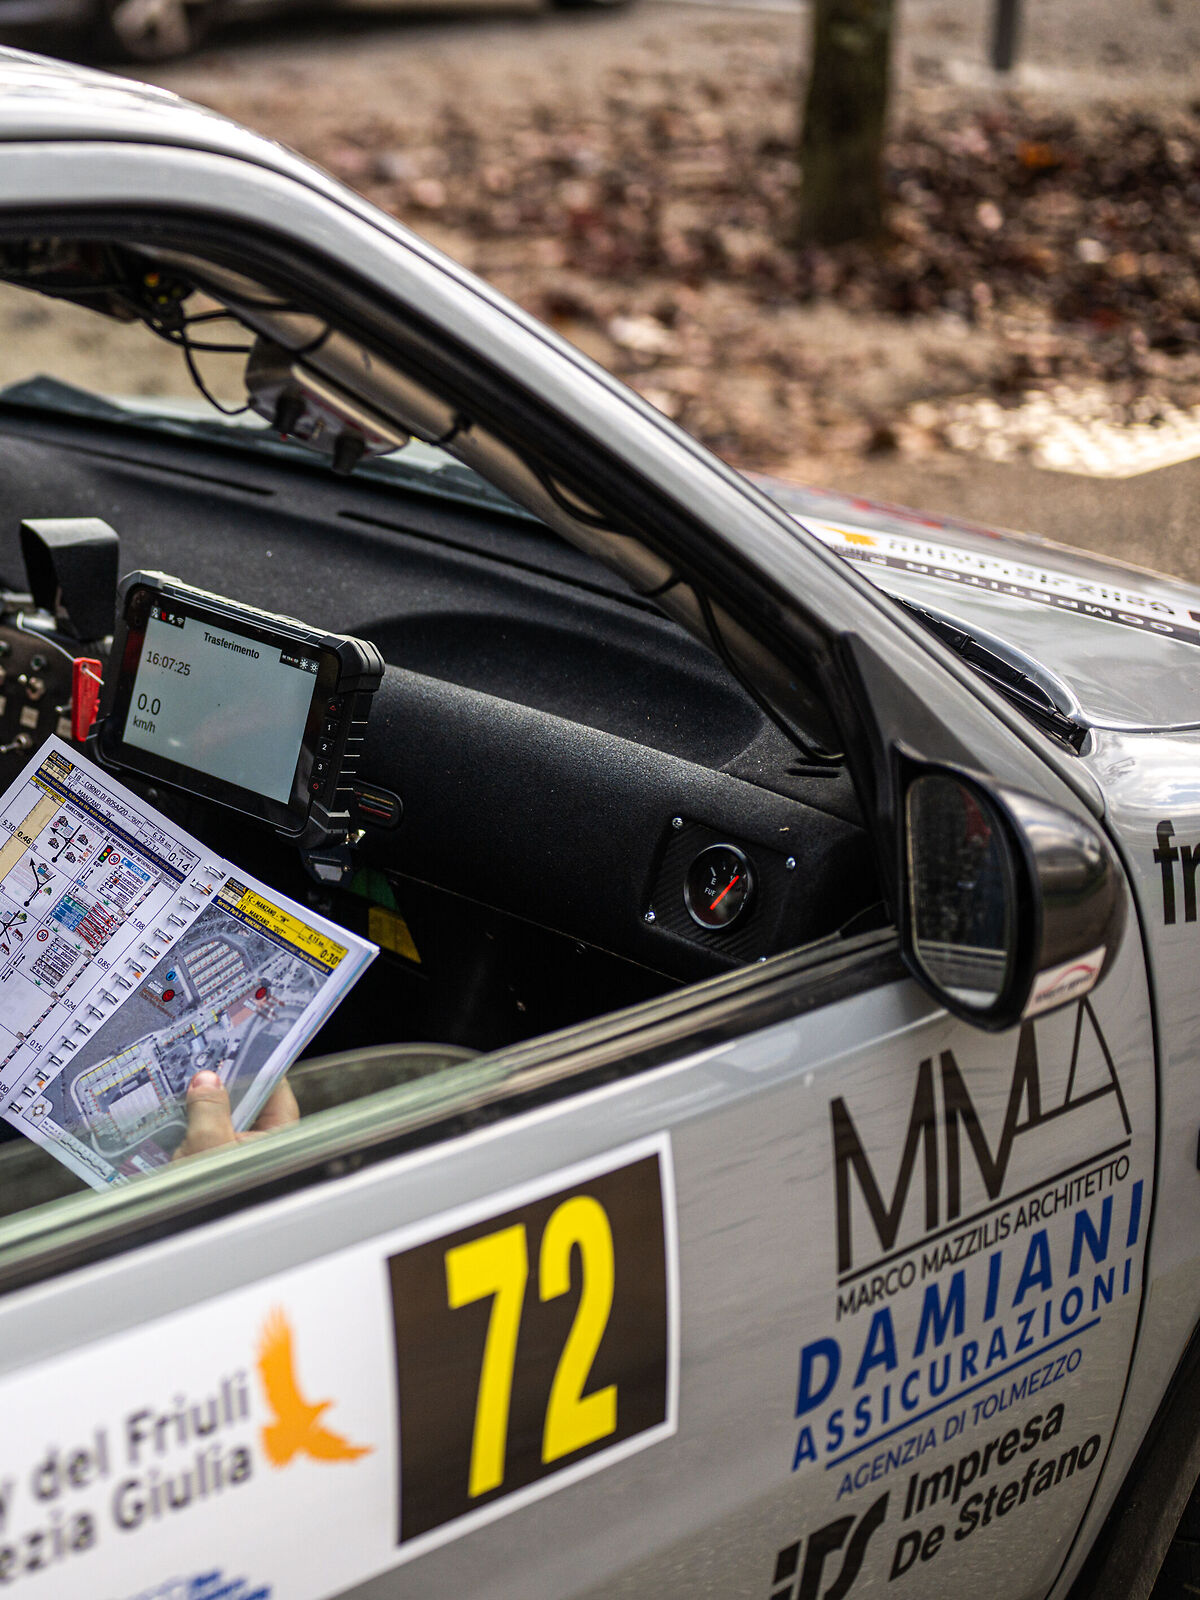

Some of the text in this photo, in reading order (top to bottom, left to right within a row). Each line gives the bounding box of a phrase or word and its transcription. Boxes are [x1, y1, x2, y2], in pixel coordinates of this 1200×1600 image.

[203, 631, 260, 660] Trasferimento
[146, 651, 191, 677] 16:07:25
[137, 693, 161, 716] 0.0
[133, 716, 156, 734] km/h
[321, 743, 328, 752] 2
[317, 763, 324, 771] 3
[37, 770, 53, 783] Without
[50, 780, 70, 796] indication,
[68, 793, 80, 803] follow
[89, 809, 99, 817] main
[97, 815, 107, 823] road
[76, 790, 102, 810] MANZANO
[84, 781, 102, 796] CORNO
[100, 793, 108, 801] DI
[105, 797, 129, 817] ROSAZZO
[65, 803, 86, 820] DIRECTION
[2, 819, 17, 832] 5.30
[16, 831, 33, 845] 0.46
[109, 837, 135, 857] INFORMATION
[164, 841, 173, 849] km
[125, 870, 145, 885] municipio
[117, 891, 130, 902] centro
[216, 899, 232, 911] Service
[230, 907, 240, 916] Park
[244, 916, 262, 931] MANZANO
[249, 909, 270, 926] MANZANO
[255, 900, 277, 917] MANZANO
[131, 918, 146, 931] 1.08
[96, 957, 111, 970] 0.85
[63, 998, 77, 1011] 0.24
[29, 1039, 44, 1052] 0.15
[835, 1154, 1131, 1321] MARCO MAZZILIS ARCHITETTO
[794, 1179, 1144, 1419] DAMIANI
[444, 1194, 618, 1499] 72
[790, 1257, 1132, 1472] ASSICURAZIONI
[836, 1348, 1083, 1501] AGENZIA DI TOLMEZZO
[29, 1428, 111, 1507] del
[126, 1367, 252, 1460] Friuli
[901, 1402, 1066, 1522] Impresa
[111, 1440, 254, 1533] Giulia
[888, 1434, 1102, 1583] De Stefano
